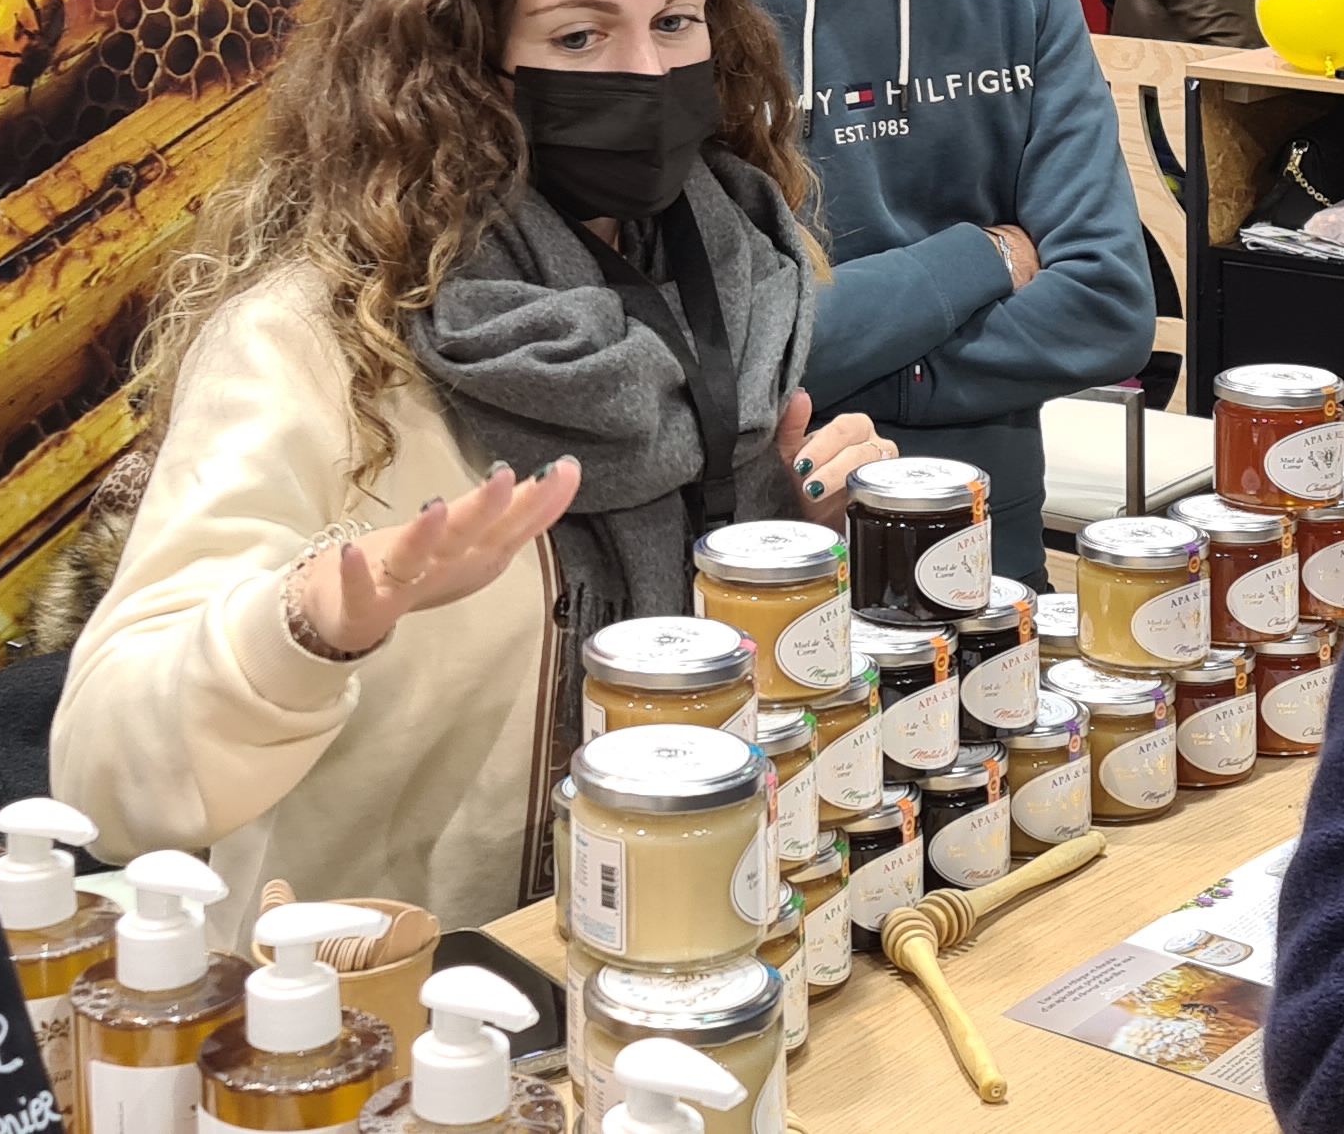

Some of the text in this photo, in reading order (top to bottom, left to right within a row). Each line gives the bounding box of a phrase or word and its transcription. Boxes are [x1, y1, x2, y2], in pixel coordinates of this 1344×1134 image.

[886, 64, 1034, 105] HILFIGER
[1304, 435, 1323, 447] APA
[957, 536, 976, 552] APA
[1170, 594, 1191, 608] APA
[819, 609, 838, 626] APA
[794, 639, 820, 648] Miel de
[1001, 657, 1021, 671] APA
[918, 696, 938, 710] APA
[1215, 710, 1235, 722] APA
[1138, 742, 1158, 754] APA
[1051, 773, 1071, 788] APA
[970, 816, 990, 831] APA
[883, 858, 904, 874] APA
